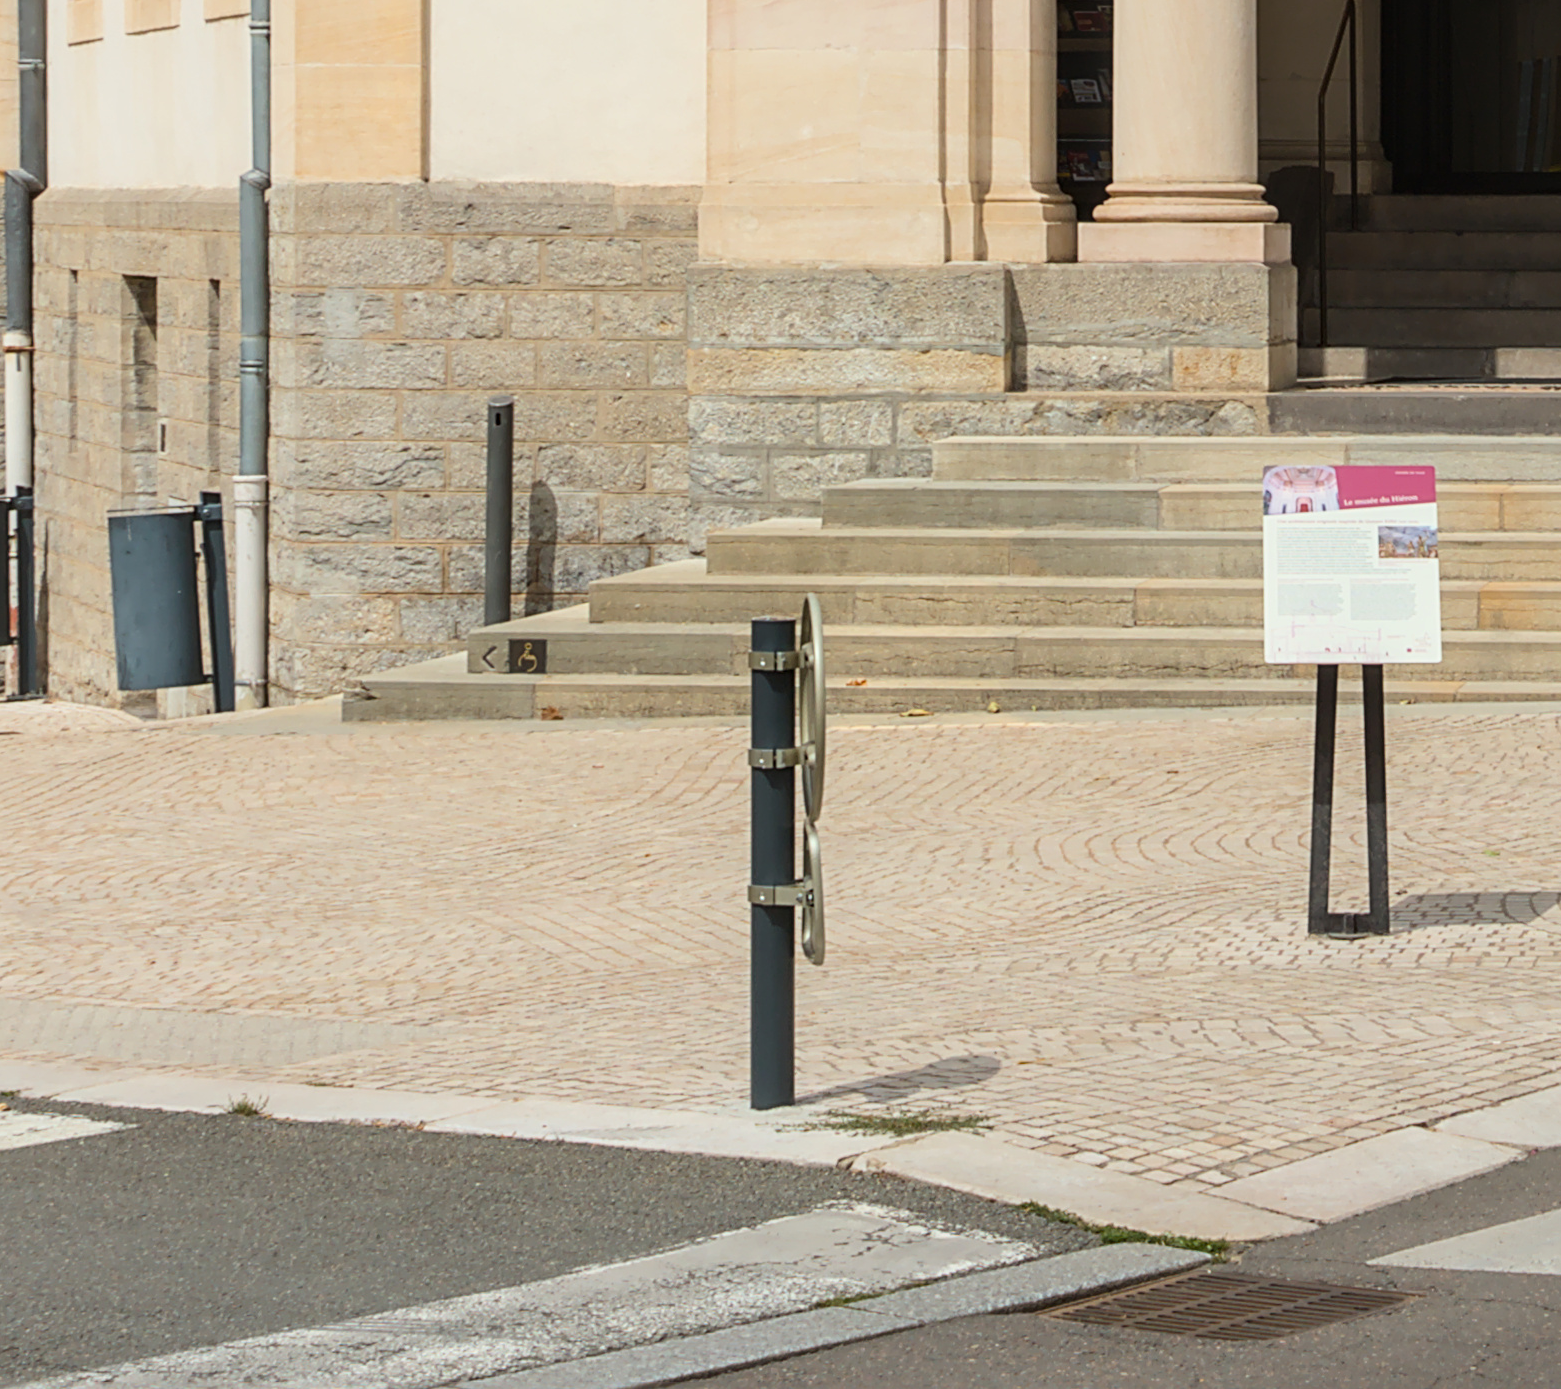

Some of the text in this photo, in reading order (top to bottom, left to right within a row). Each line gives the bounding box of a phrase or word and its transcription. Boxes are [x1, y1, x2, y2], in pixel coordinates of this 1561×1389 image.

[1344, 494, 1418, 506] Le musée du Hiéron
